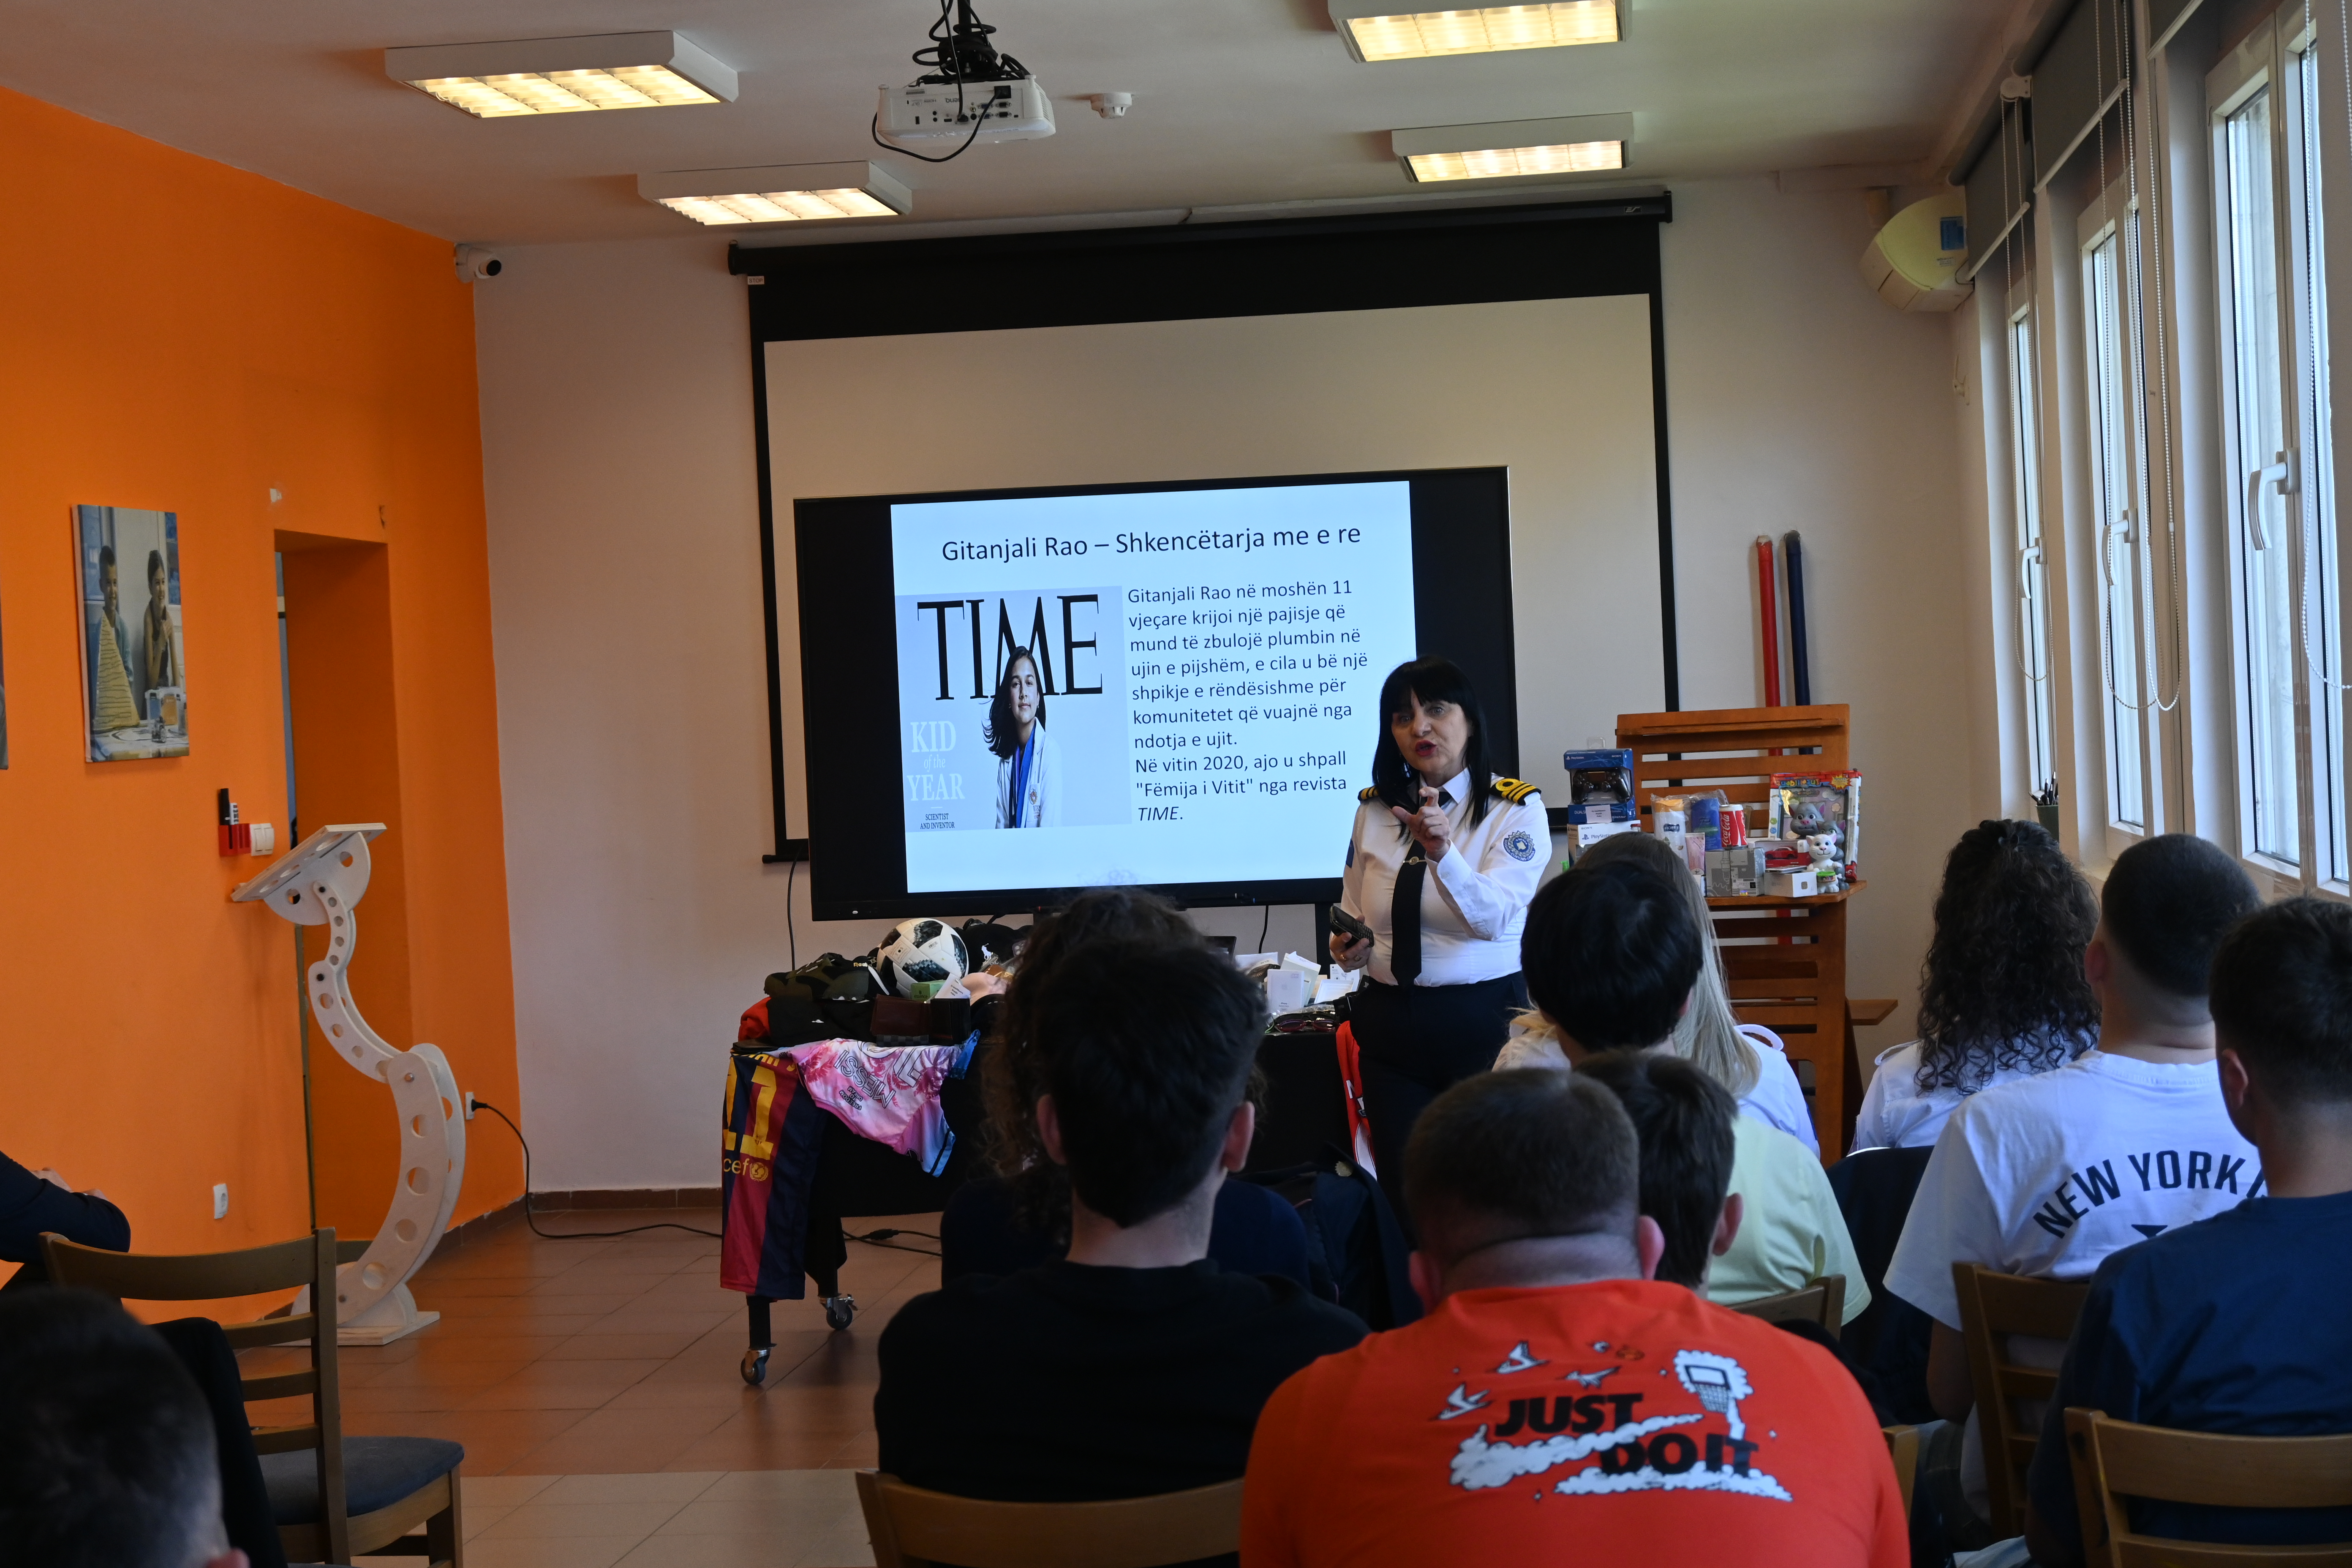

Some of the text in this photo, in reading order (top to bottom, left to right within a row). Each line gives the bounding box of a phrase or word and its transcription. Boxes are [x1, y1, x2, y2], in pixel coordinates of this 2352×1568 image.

[942, 537, 1036, 563] Gitanjali
[1045, 537, 1087, 556] Rao
[1116, 528, 1264, 553] Shkencëtarja
[1274, 531, 1309, 546] me
[1318, 530, 1330, 544] e
[1339, 528, 1360, 543] re
[1128, 580, 1352, 604] Gitanjali Rao në moshën 11
[1129, 604, 1345, 630] vjeçare krijoi një pajisje që
[917, 594, 1102, 701] TIME
[1131, 629, 1360, 651] mund të zbulojë plumbin në
[1132, 653, 1367, 679] ujin e pijshëm, e cila u bë një
[1132, 678, 1346, 702] shpikje e rëndësishme për
[1134, 704, 1351, 724] komunitetet që vuajnë nga
[910, 721, 956, 752] KID
[1135, 731, 1237, 751] ndotja e ujit.
[924, 754, 946, 772] of the
[1136, 751, 1345, 773] Në vitin 2020, ajo u shpall
[906, 773, 965, 801] YEAR
[1260, 781, 1287, 795] nga
[1294, 776, 1346, 791] revista
[1138, 806, 1183, 821] TIME.
[833, 1050, 896, 1108] MESSI
[839, 1090, 862, 1110] FREEDOM
[847, 1086, 863, 1102] DREAM
[2033, 1159, 2121, 1239] NEW
[1494, 1393, 1643, 1436] JUST
